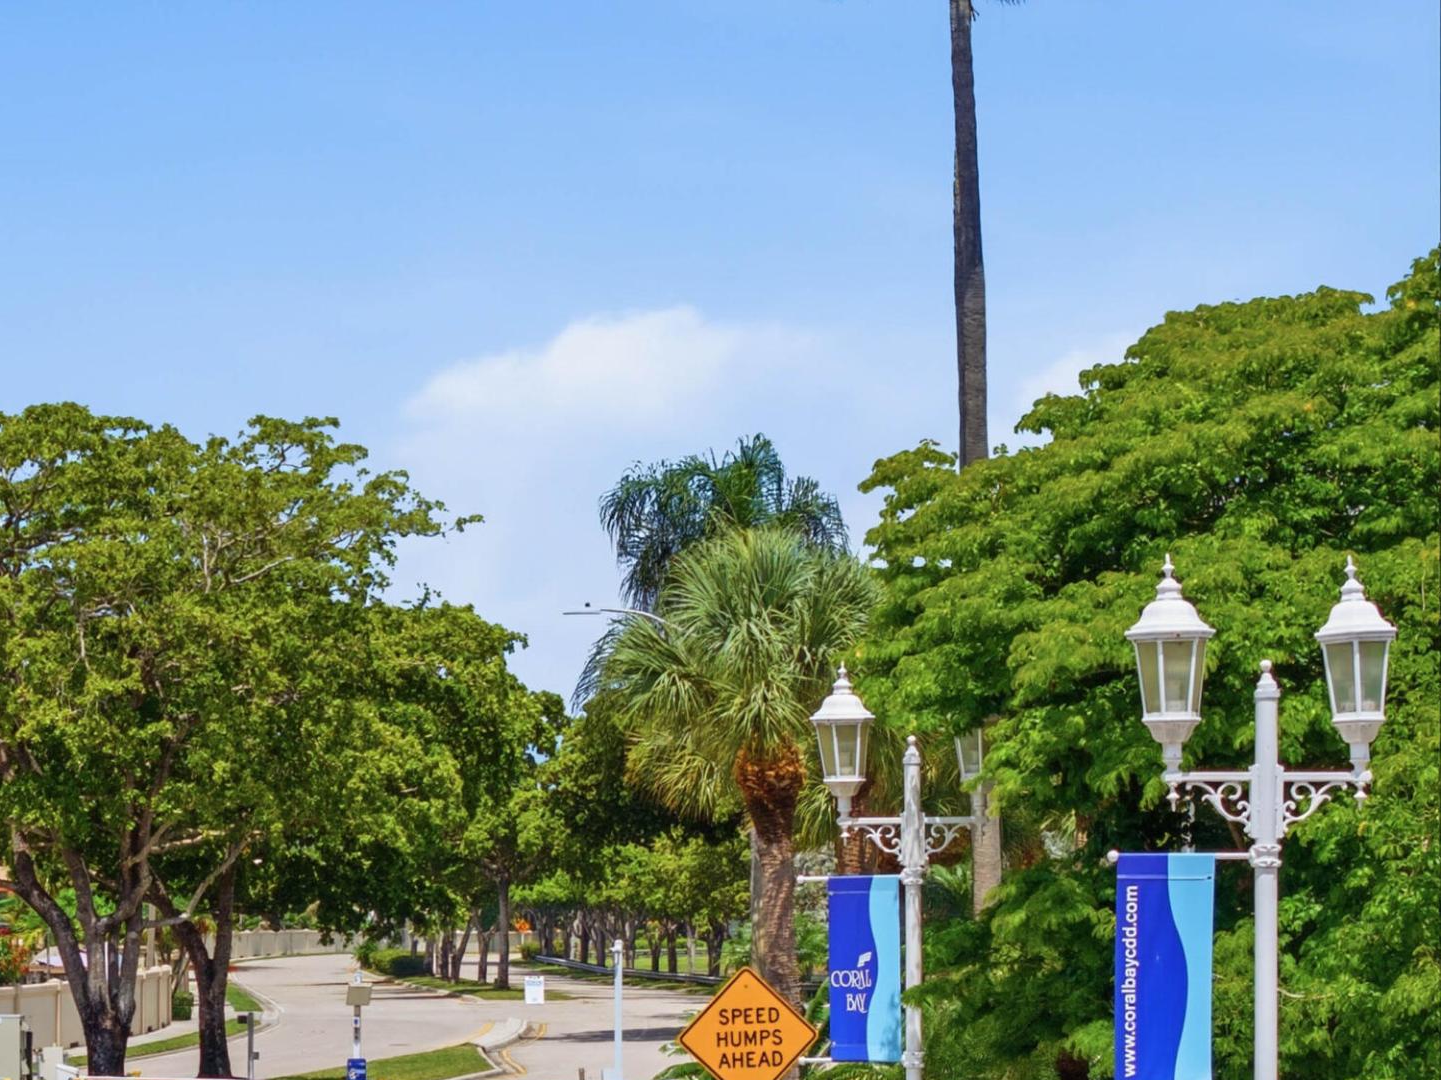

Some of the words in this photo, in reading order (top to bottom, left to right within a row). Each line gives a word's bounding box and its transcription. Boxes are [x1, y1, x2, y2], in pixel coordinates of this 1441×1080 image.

[830, 969, 872, 990] CORAL
[1121, 885, 1140, 1078] www.coralbaycdd.com
[846, 993, 868, 1013] BAY
[719, 1007, 780, 1026] SPEED
[716, 1029, 783, 1048] HUMPS
[718, 1050, 784, 1069] AHEAD
